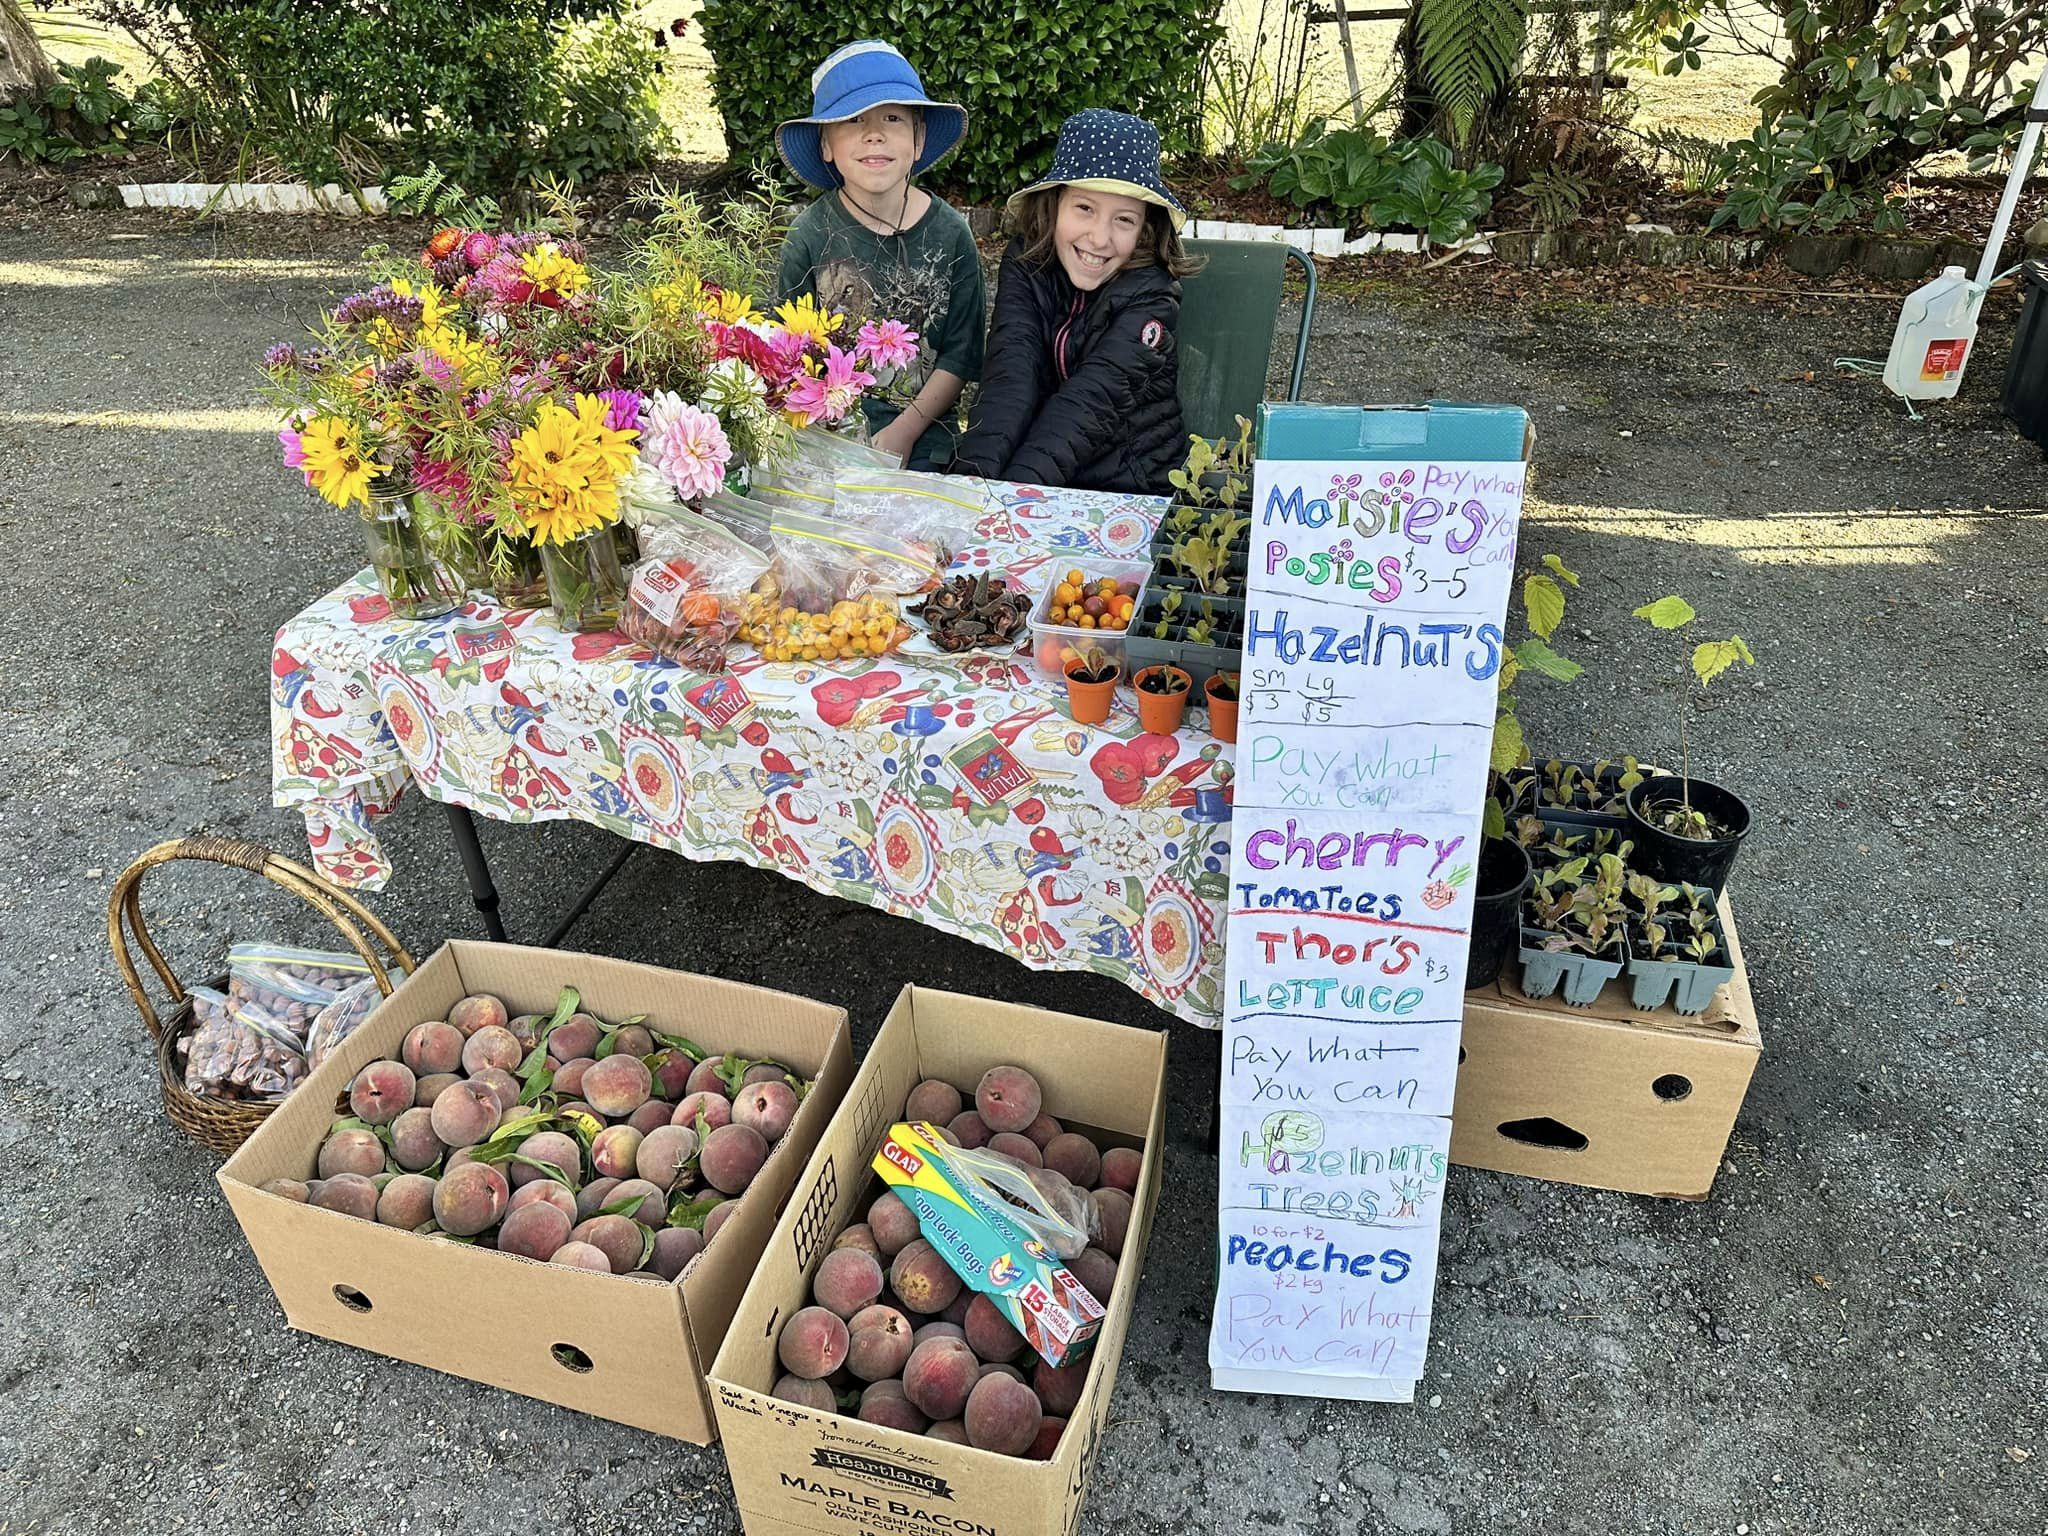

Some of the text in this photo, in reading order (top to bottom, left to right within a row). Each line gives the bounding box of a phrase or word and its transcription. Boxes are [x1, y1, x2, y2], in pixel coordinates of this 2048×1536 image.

[1422, 464, 1471, 495] Pay
[1263, 477, 1489, 554] Maisie's
[1487, 508, 1518, 538] You
[1266, 540, 1402, 603] Posies
[706, 689, 748, 726] ITALIA
[1245, 693, 1332, 726] $3 $5
[1252, 735, 1341, 784] Pay
[980, 764, 1030, 800] ITALIA
[1277, 781, 1324, 808] You
[1256, 925, 1421, 975] Thor's
[1425, 957, 1450, 983] $3
[1231, 1035, 1292, 1076] Pay
[1252, 1074, 1313, 1102] You
[1272, 1114, 1309, 1142] $5
[883, 1141, 920, 1174] GLAD
[1248, 1183, 1381, 1223] Trees
[1253, 1225, 1326, 1241] 10 for $2
[956, 1242, 985, 1275] Bags
[1058, 1269, 1077, 1289] 15
[1273, 1272, 1323, 1294] $2 kg
[1024, 1282, 1048, 1313] 15
[1042, 1307, 1070, 1338] STORAGE
[1049, 1304, 1071, 1327] LARGE
[1237, 1337, 1308, 1364] You
[823, 1452, 938, 1490] Heartland
[847, 1470, 886, 1485] POTATO
[780, 1472, 997, 1536] MAPLE BACON
[825, 1500, 953, 1536] OLD-FASHIONED
[824, 1508, 905, 1534] WAVE CUT
